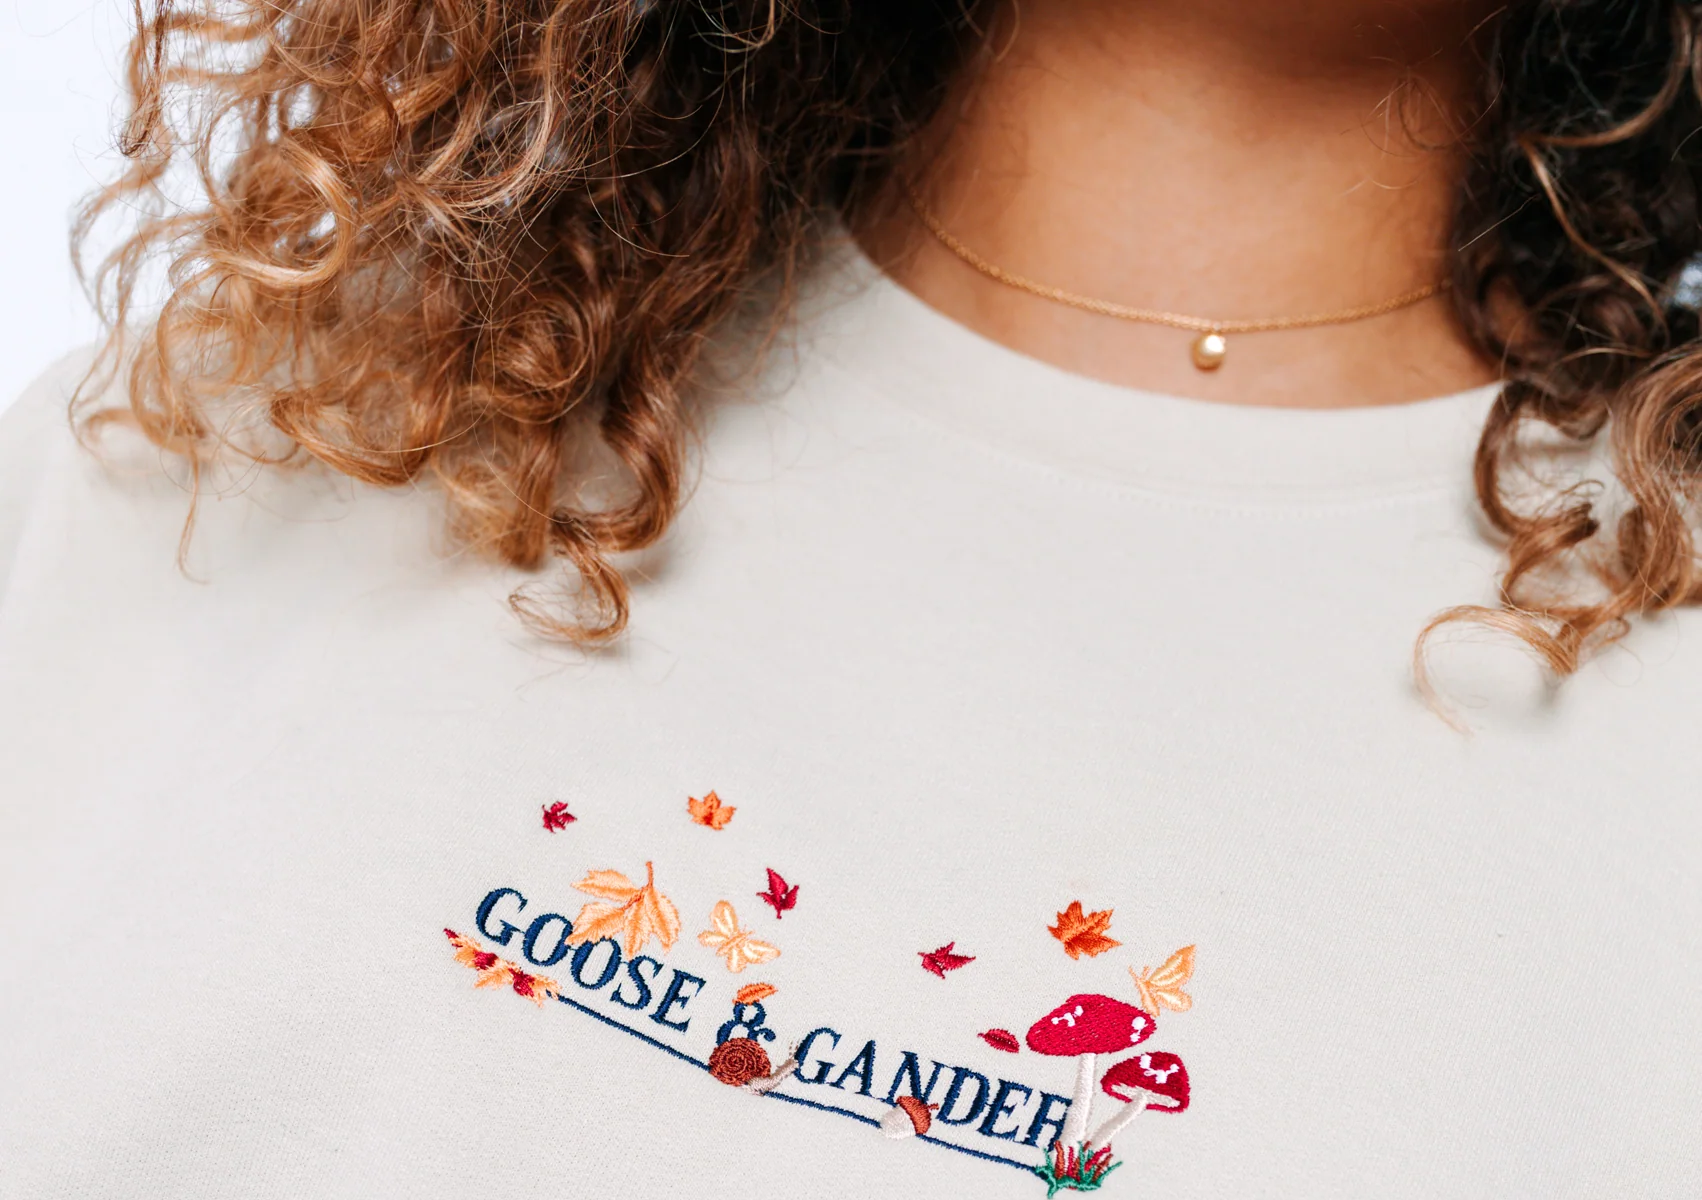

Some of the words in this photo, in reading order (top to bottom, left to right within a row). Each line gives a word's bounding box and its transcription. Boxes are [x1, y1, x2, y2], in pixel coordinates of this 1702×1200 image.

[475, 887, 707, 1033] GOOSE
[715, 1001, 777, 1049] &
[793, 1027, 1074, 1151] GANDER
